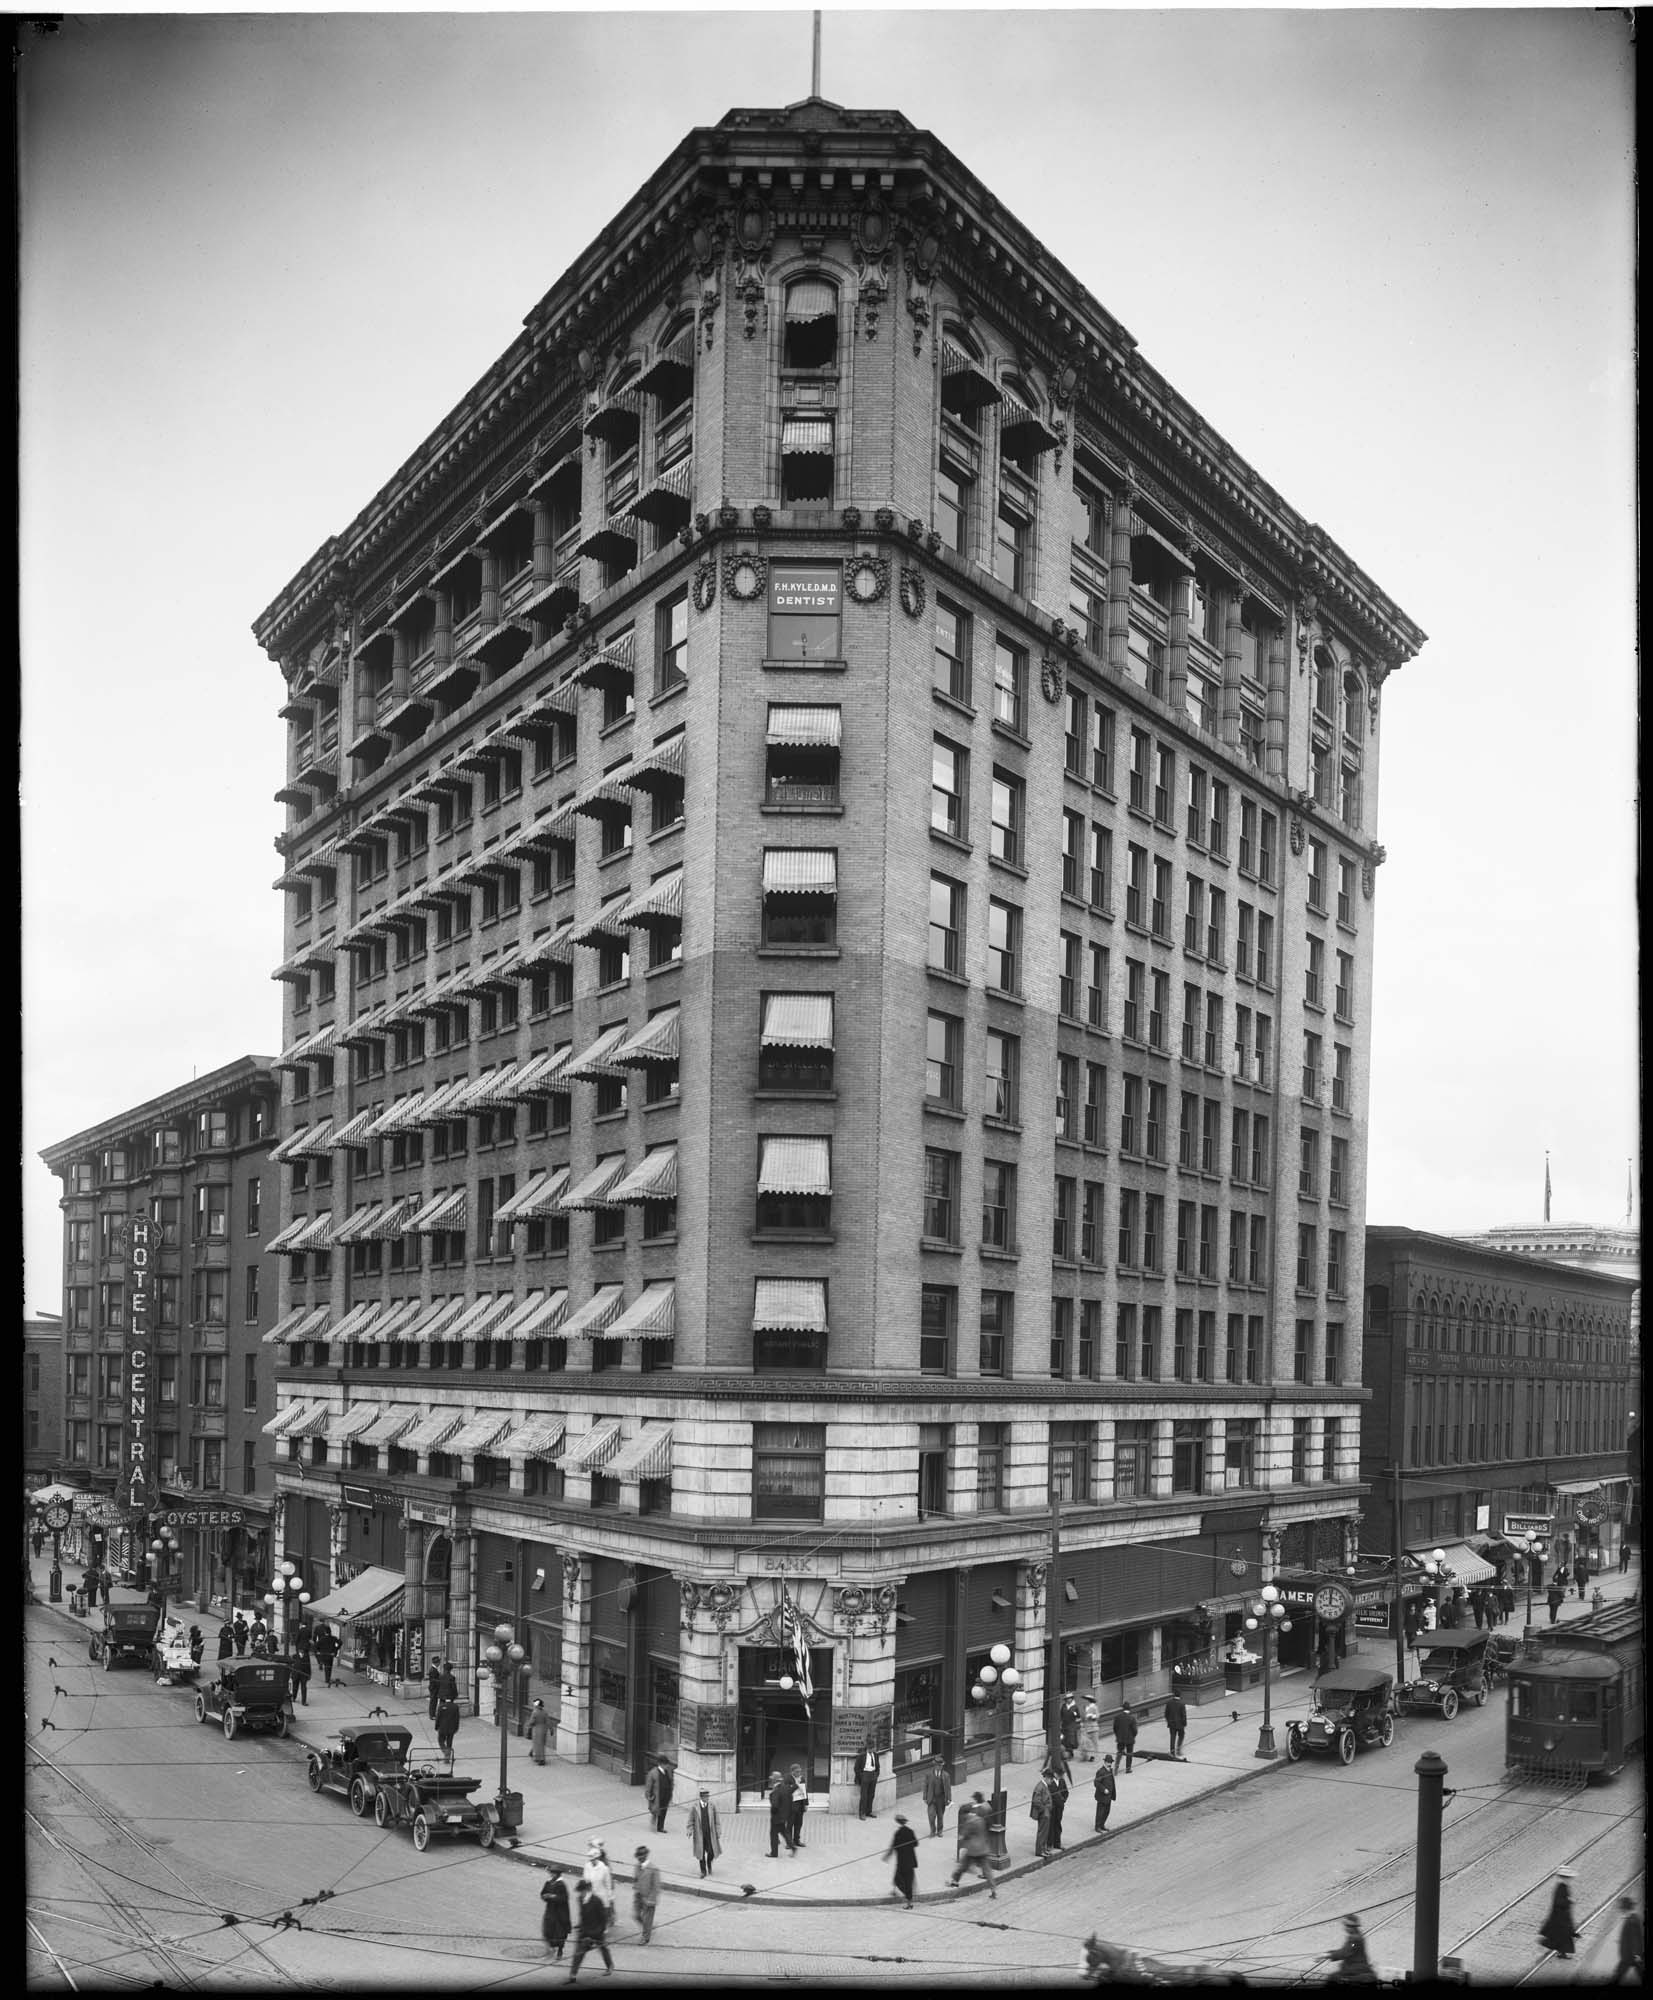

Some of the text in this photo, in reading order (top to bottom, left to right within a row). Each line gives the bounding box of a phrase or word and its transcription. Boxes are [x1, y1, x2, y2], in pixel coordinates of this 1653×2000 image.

[776, 596, 835, 605] DENTIST
[132, 1224, 148, 1335] HOTEL
[129, 1350, 147, 1507] CENTRAL
[167, 1511, 241, 1525] OYSTERS
[1511, 1521, 1548, 1531] BILLIARDS
[765, 1558, 811, 1571] BANK
